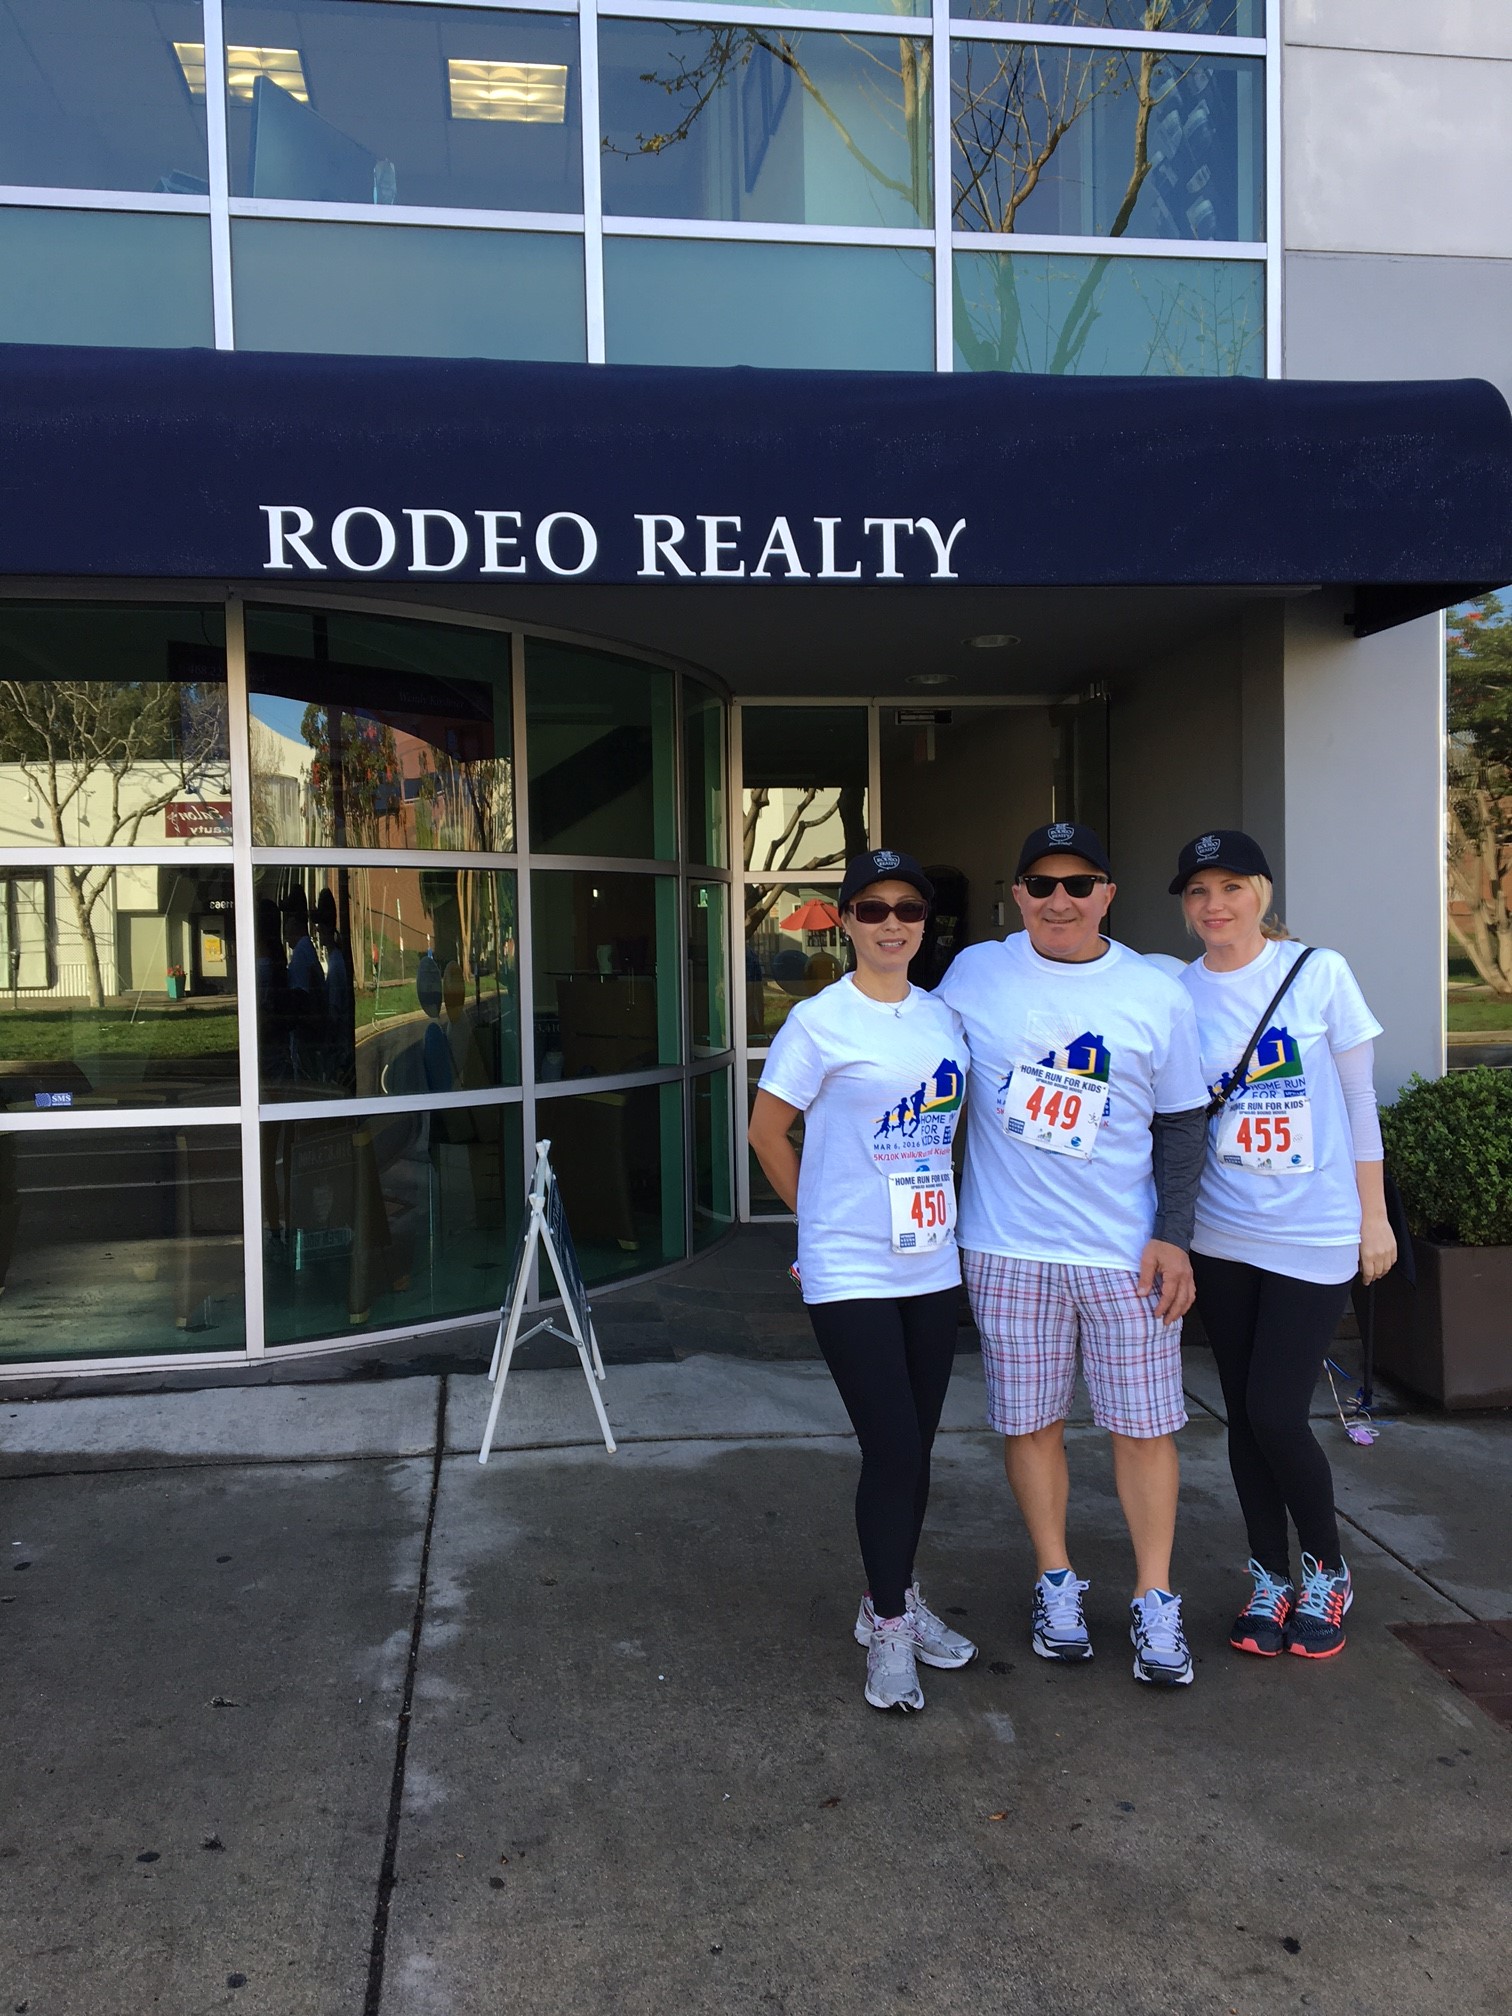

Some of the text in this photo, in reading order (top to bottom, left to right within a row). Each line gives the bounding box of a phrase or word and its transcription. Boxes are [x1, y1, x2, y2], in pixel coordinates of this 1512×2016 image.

[258, 504, 967, 579] RODEO REALTY
[1020, 1064, 1102, 1094] HOME RUN FOR KIDS
[1250, 1077, 1306, 1090] HOME RUN
[51, 1094, 72, 1103] SMS
[1252, 1090, 1277, 1099] FOR
[1026, 1085, 1082, 1131] 449
[1247, 1102, 1263, 1110] RUN
[1265, 1102, 1282, 1110] FOR
[1284, 1100, 1304, 1110] KIDS
[920, 1114, 946, 1124] HOME
[921, 1124, 938, 1135] FOR
[1236, 1117, 1291, 1153] 455
[873, 1153, 899, 1161] 5K/10K
[895, 1173, 950, 1186] HOME RUN FOR KIDS
[911, 1189, 946, 1229] 450
